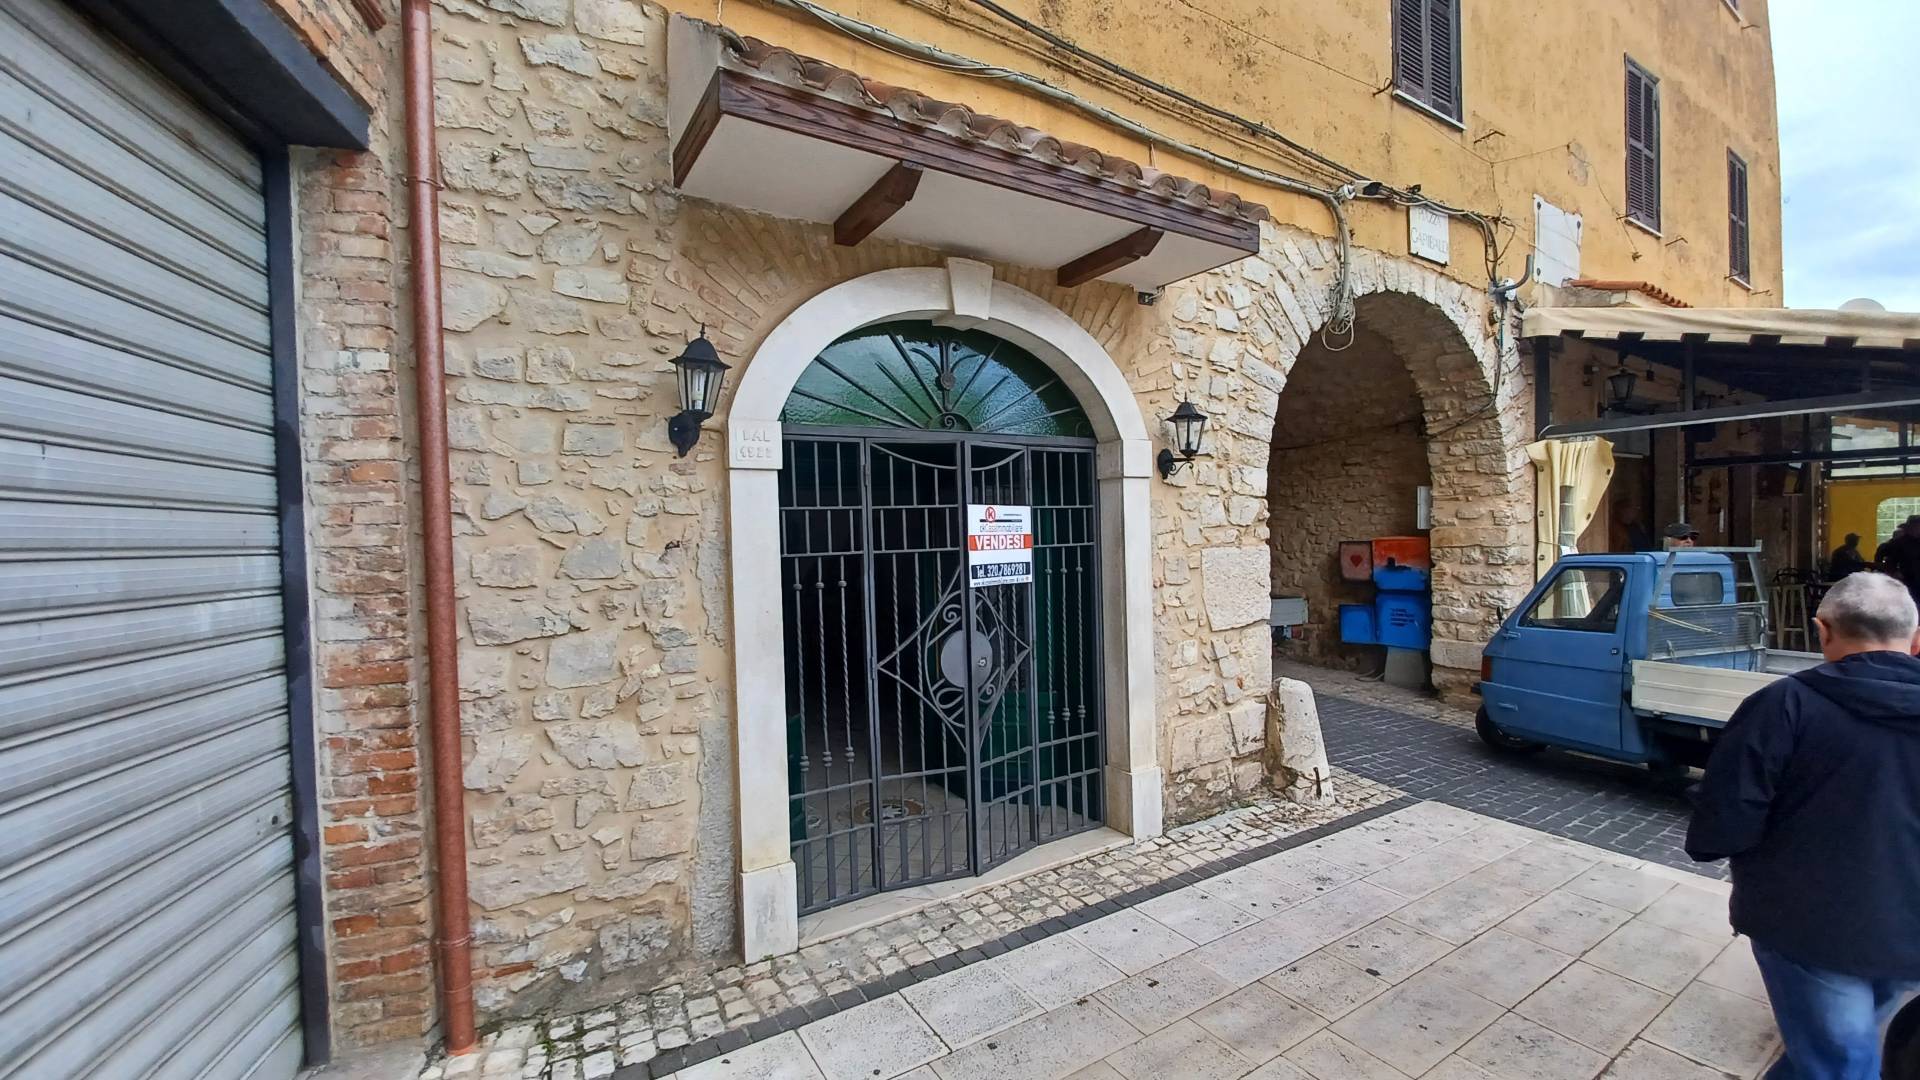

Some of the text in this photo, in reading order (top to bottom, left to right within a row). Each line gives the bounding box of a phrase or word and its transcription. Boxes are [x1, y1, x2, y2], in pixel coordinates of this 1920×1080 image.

[742, 430, 772, 442] DAL
[975, 535, 1024, 550] VENDESI
[976, 565, 986, 579] Tel.
